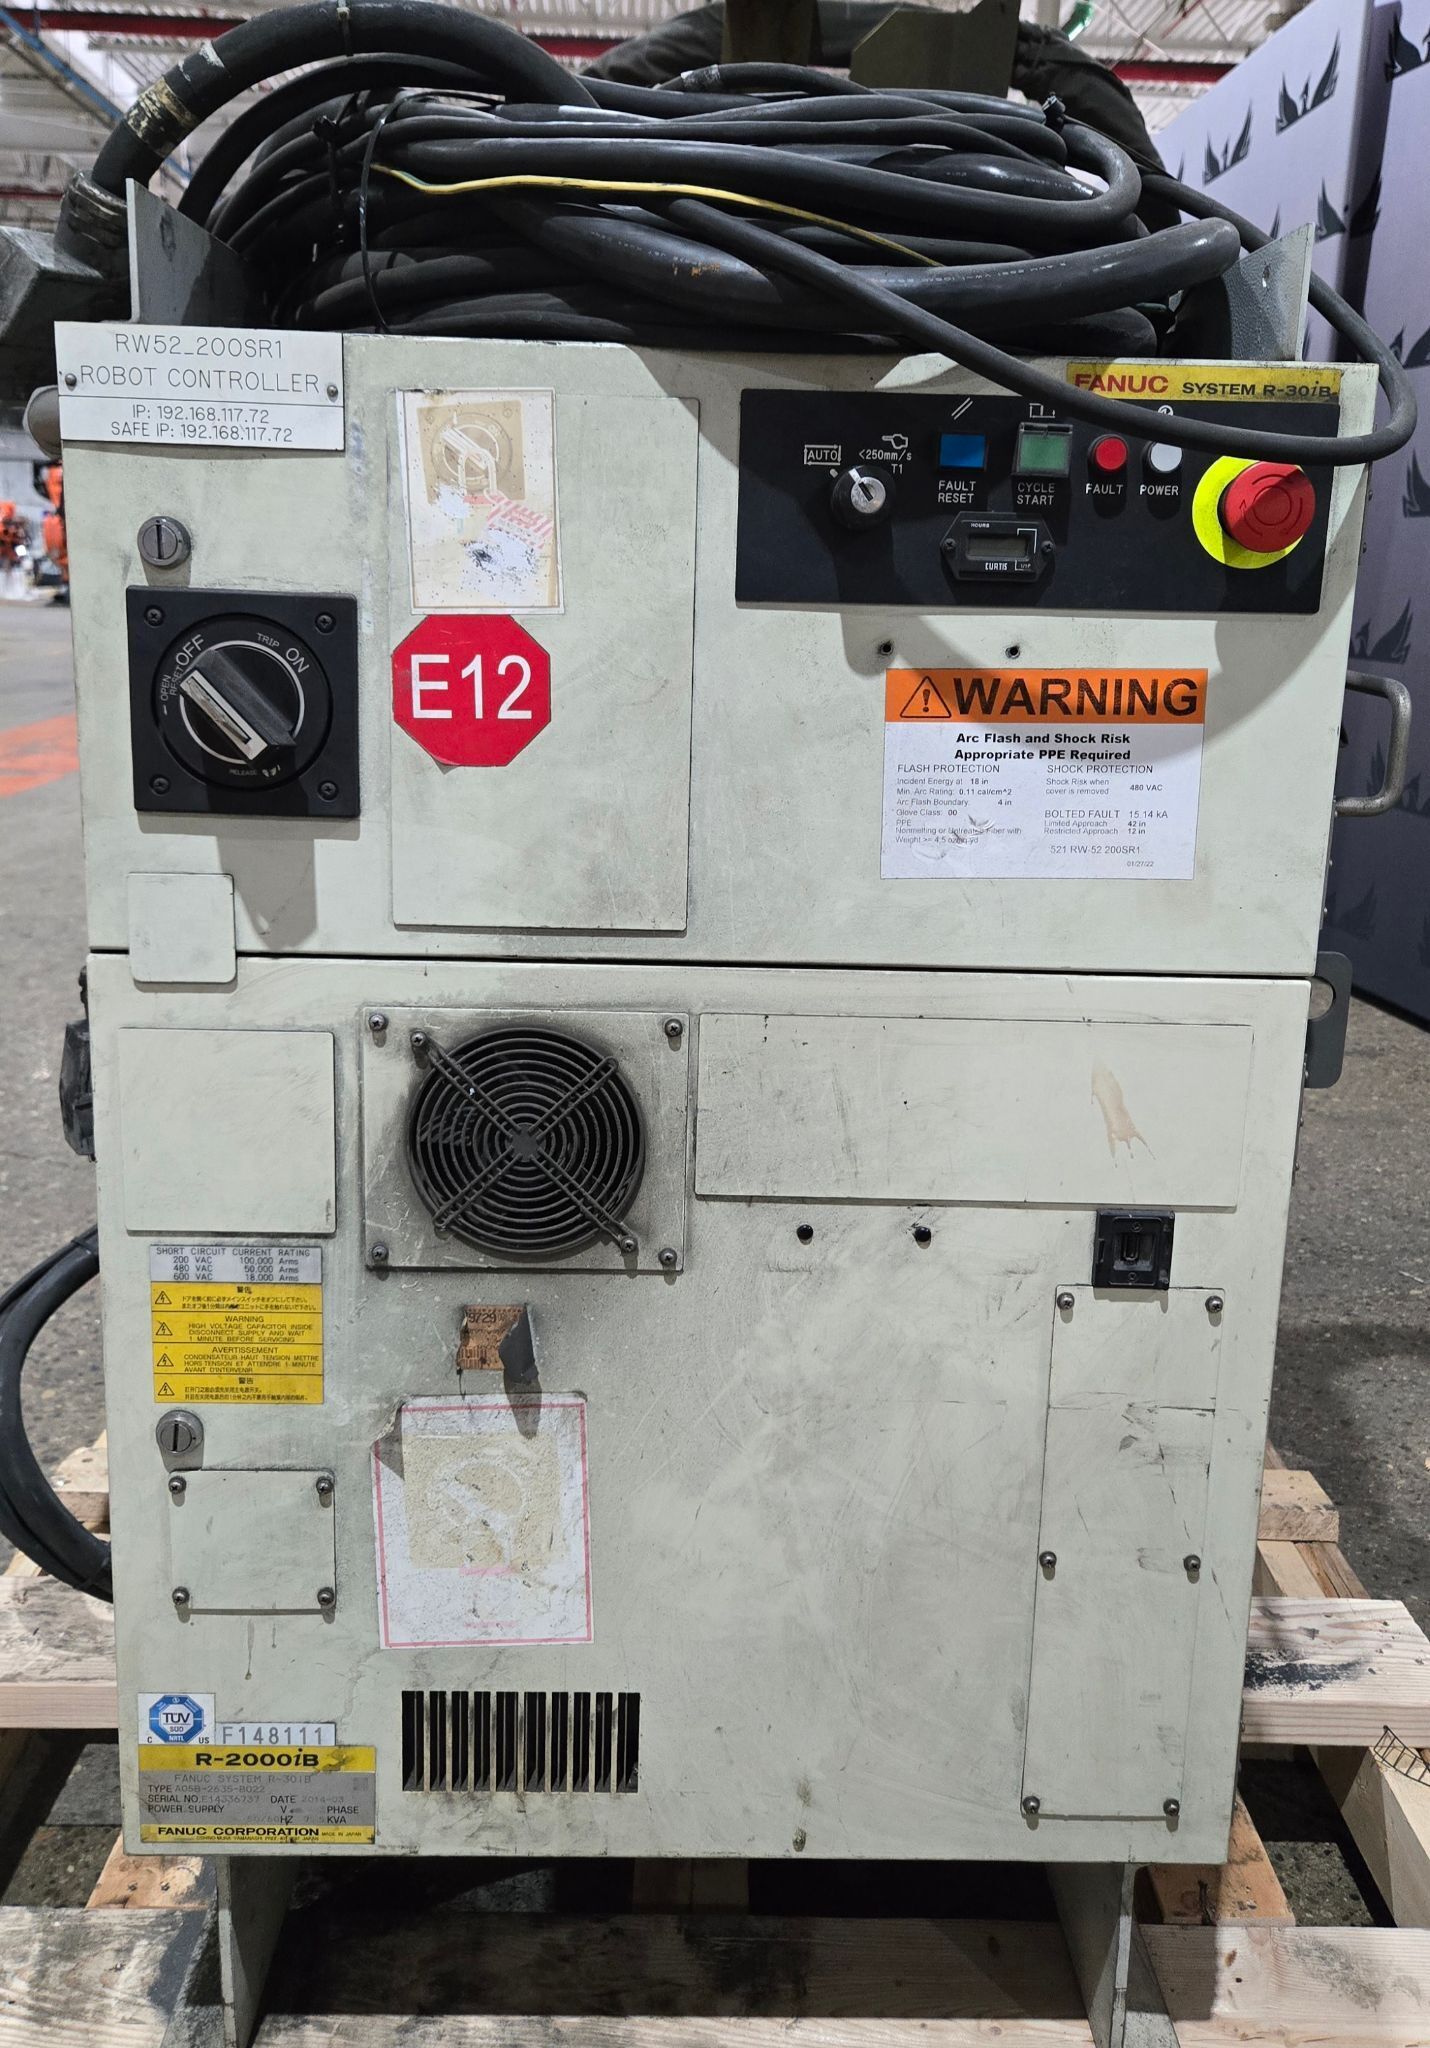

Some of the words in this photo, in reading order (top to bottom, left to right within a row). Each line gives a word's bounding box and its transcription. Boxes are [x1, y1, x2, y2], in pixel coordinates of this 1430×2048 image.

[115, 333, 282, 359] RW52_200SR1
[80, 365, 158, 387] ROBOT
[168, 368, 320, 393] CONTROLLER
[1074, 373, 1169, 394] FANUC
[1182, 382, 1255, 396] SYSTEM
[1262, 380, 1331, 397] R-30iB
[132, 404, 151, 419] IP:
[157, 405, 270, 424] 192.168.117.72
[111, 422, 151, 437] SAFE
[156, 424, 174, 438] IP:
[181, 424, 293, 442] 192.168.117.72
[807, 451, 838, 461] AUTO
[858, 450, 912, 461] <250mm/s
[891, 464, 903, 474] T1
[938, 480, 976, 491] FAULT
[1018, 483, 1055, 493] CYCLE
[1085, 484, 1124, 495] FAULT
[1139, 485, 1179, 495] POWER
[938, 493, 975, 503] RESET
[1017, 495, 1055, 505] START
[985, 562, 1008, 570] CURTIS
[256, 632, 280, 648] TRIP
[175, 634, 205, 666] OFF
[285, 647, 310, 673] ON
[169, 666, 184, 696] RESET
[161, 674, 172, 701] OPEN
[411, 654, 532, 720] E12
[954, 677, 1198, 716] WARNING
[956, 733, 979, 743] Arc
[984, 733, 1020, 743] Flash
[1025, 733, 1050, 743] and
[1054, 733, 1096, 744] Shock
[1101, 733, 1130, 744] Risk
[954, 750, 1034, 761] Appropriate
[1039, 750, 1066, 760] PPE
[1070, 750, 1131, 762] Required
[897, 764, 930, 773] FLASH
[933, 764, 1000, 773] PROTECTION
[1047, 765, 1084, 773] SHOCK
[1087, 765, 1153, 774] PROTECTION
[928, 778, 954, 786] Energy
[1044, 810, 1085, 818] BOLTED
[1088, 810, 1120, 818] FAULT
[1072, 820, 1108, 828] Approach
[896, 827, 937, 835] Nonmelting
[1083, 828, 1118, 836] Approach
[1050, 846, 1066, 854] 521
[156, 1247, 185, 1255] SHORT
[191, 1248, 226, 1256] CIRCUIT
[232, 1248, 272, 1256] CURRENT
[278, 1248, 310, 1256] RATING
[173, 1256, 189, 1264] 200
[195, 1256, 212, 1264] VAC
[212, 1346, 278, 1354] AVERTISSEMENT
[162, 1712, 190, 1723] TÜV
[147, 1736, 152, 1744] C
[222, 1727, 322, 1744] F148111
[196, 1748, 319, 1767] R-2000iB
[174, 1774, 210, 1783] FANUC
[218, 1775, 261, 1783] SYSTEM
[148, 1795, 180, 1803] SERIAL
[184, 1795, 200, 1803] NO.
[148, 1805, 182, 1813] POWER
[188, 1805, 224, 1813] SUPPLY
[327, 1806, 359, 1814] PHASE
[213, 1828, 319, 1836] CORPORATION
